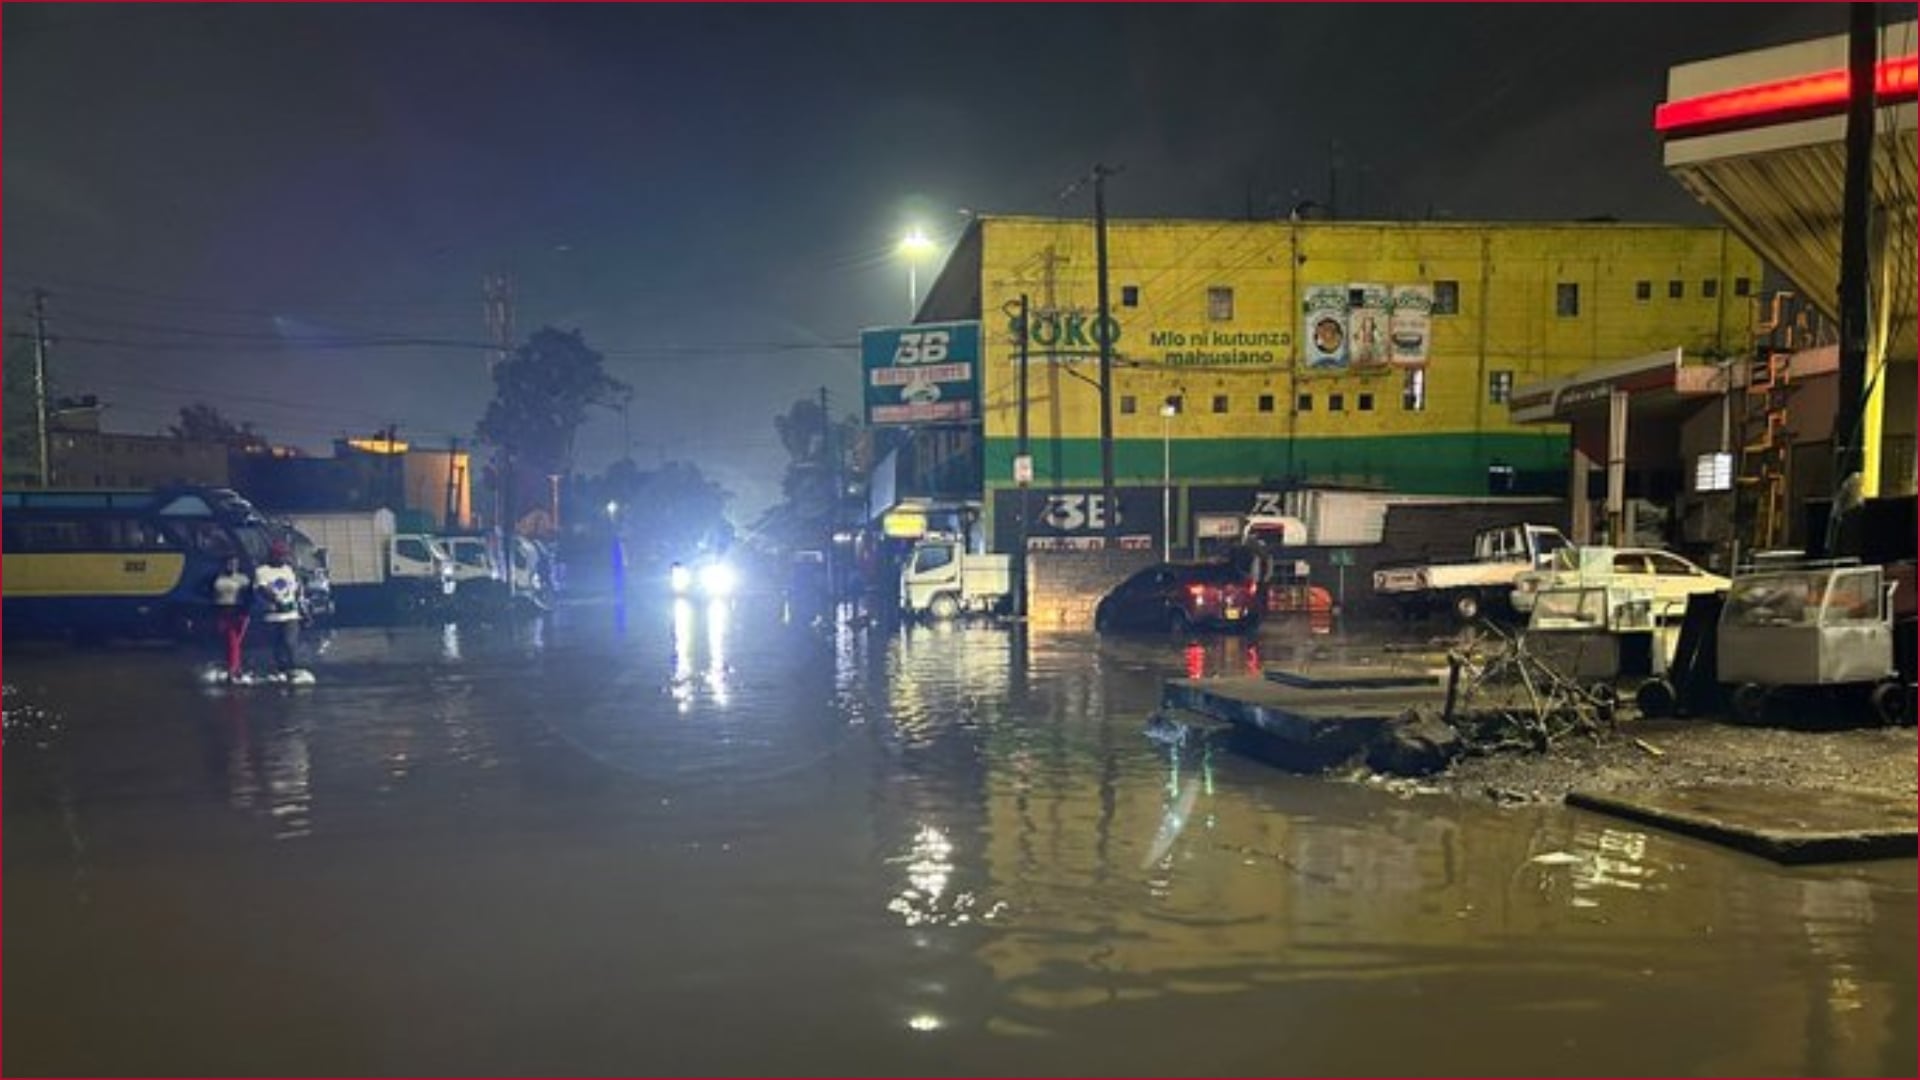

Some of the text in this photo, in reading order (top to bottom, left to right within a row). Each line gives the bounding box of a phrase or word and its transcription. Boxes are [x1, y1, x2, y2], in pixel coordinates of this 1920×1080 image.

[1191, 332, 1208, 346] ni
[1213, 331, 1290, 346] kutunza
[1165, 349, 1273, 366] mahusiano
